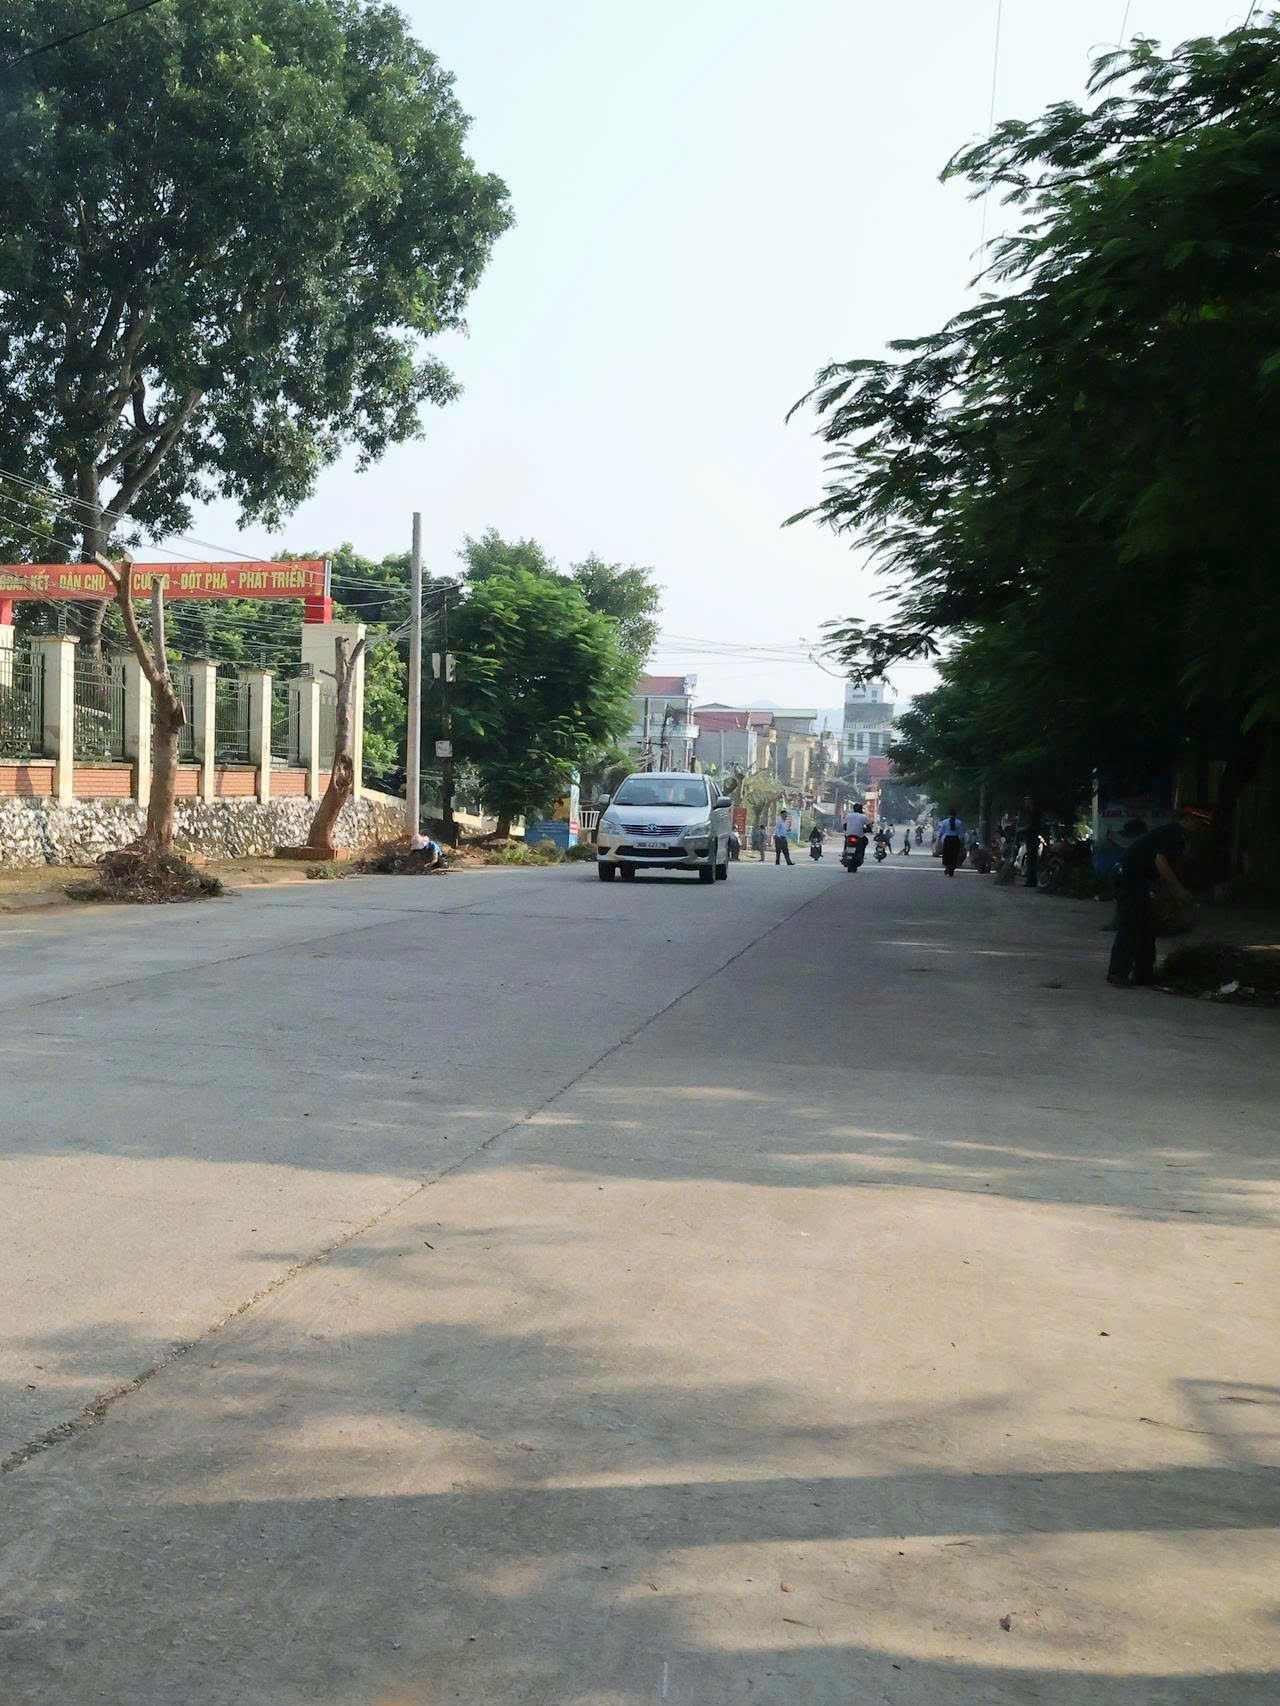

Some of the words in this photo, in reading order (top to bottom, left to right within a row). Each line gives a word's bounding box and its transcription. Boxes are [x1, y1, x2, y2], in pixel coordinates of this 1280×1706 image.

[31, 569, 50, 591] KẾT
[59, 571, 81, 591] DÂN
[83, 569, 106, 591] CHỦ
[205, 568, 228, 590] PHÁ
[239, 568, 268, 589] PHÁT
[271, 563, 305, 589] TRIỂN
